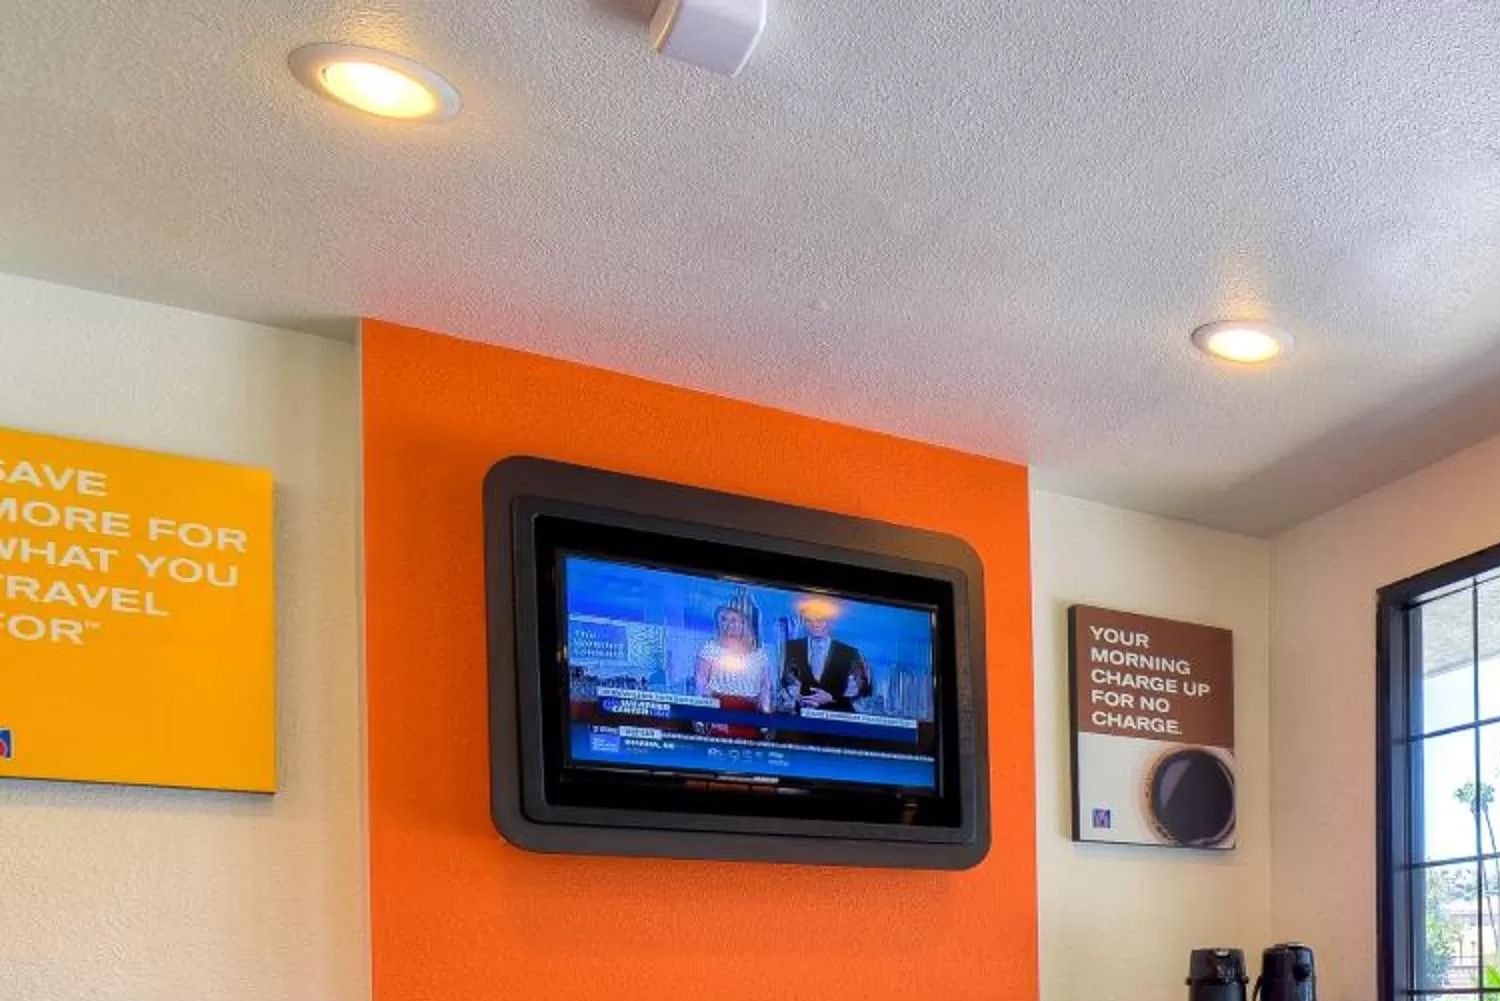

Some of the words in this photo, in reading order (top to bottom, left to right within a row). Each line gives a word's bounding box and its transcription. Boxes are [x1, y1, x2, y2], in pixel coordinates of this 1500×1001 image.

[0, 459, 109, 497] AVE
[148, 518, 248, 553] FOR
[137, 553, 239, 588] YOU
[0, 573, 170, 617] RAVEL
[1089, 625, 1150, 648] YOUR
[1091, 648, 1191, 675] MORNING
[1091, 669, 1178, 694] CHARGE
[1184, 681, 1211, 697] UP
[1091, 689, 1135, 710] FOR
[1140, 695, 1171, 713] NO
[1091, 711, 1183, 736] CHARGE.
